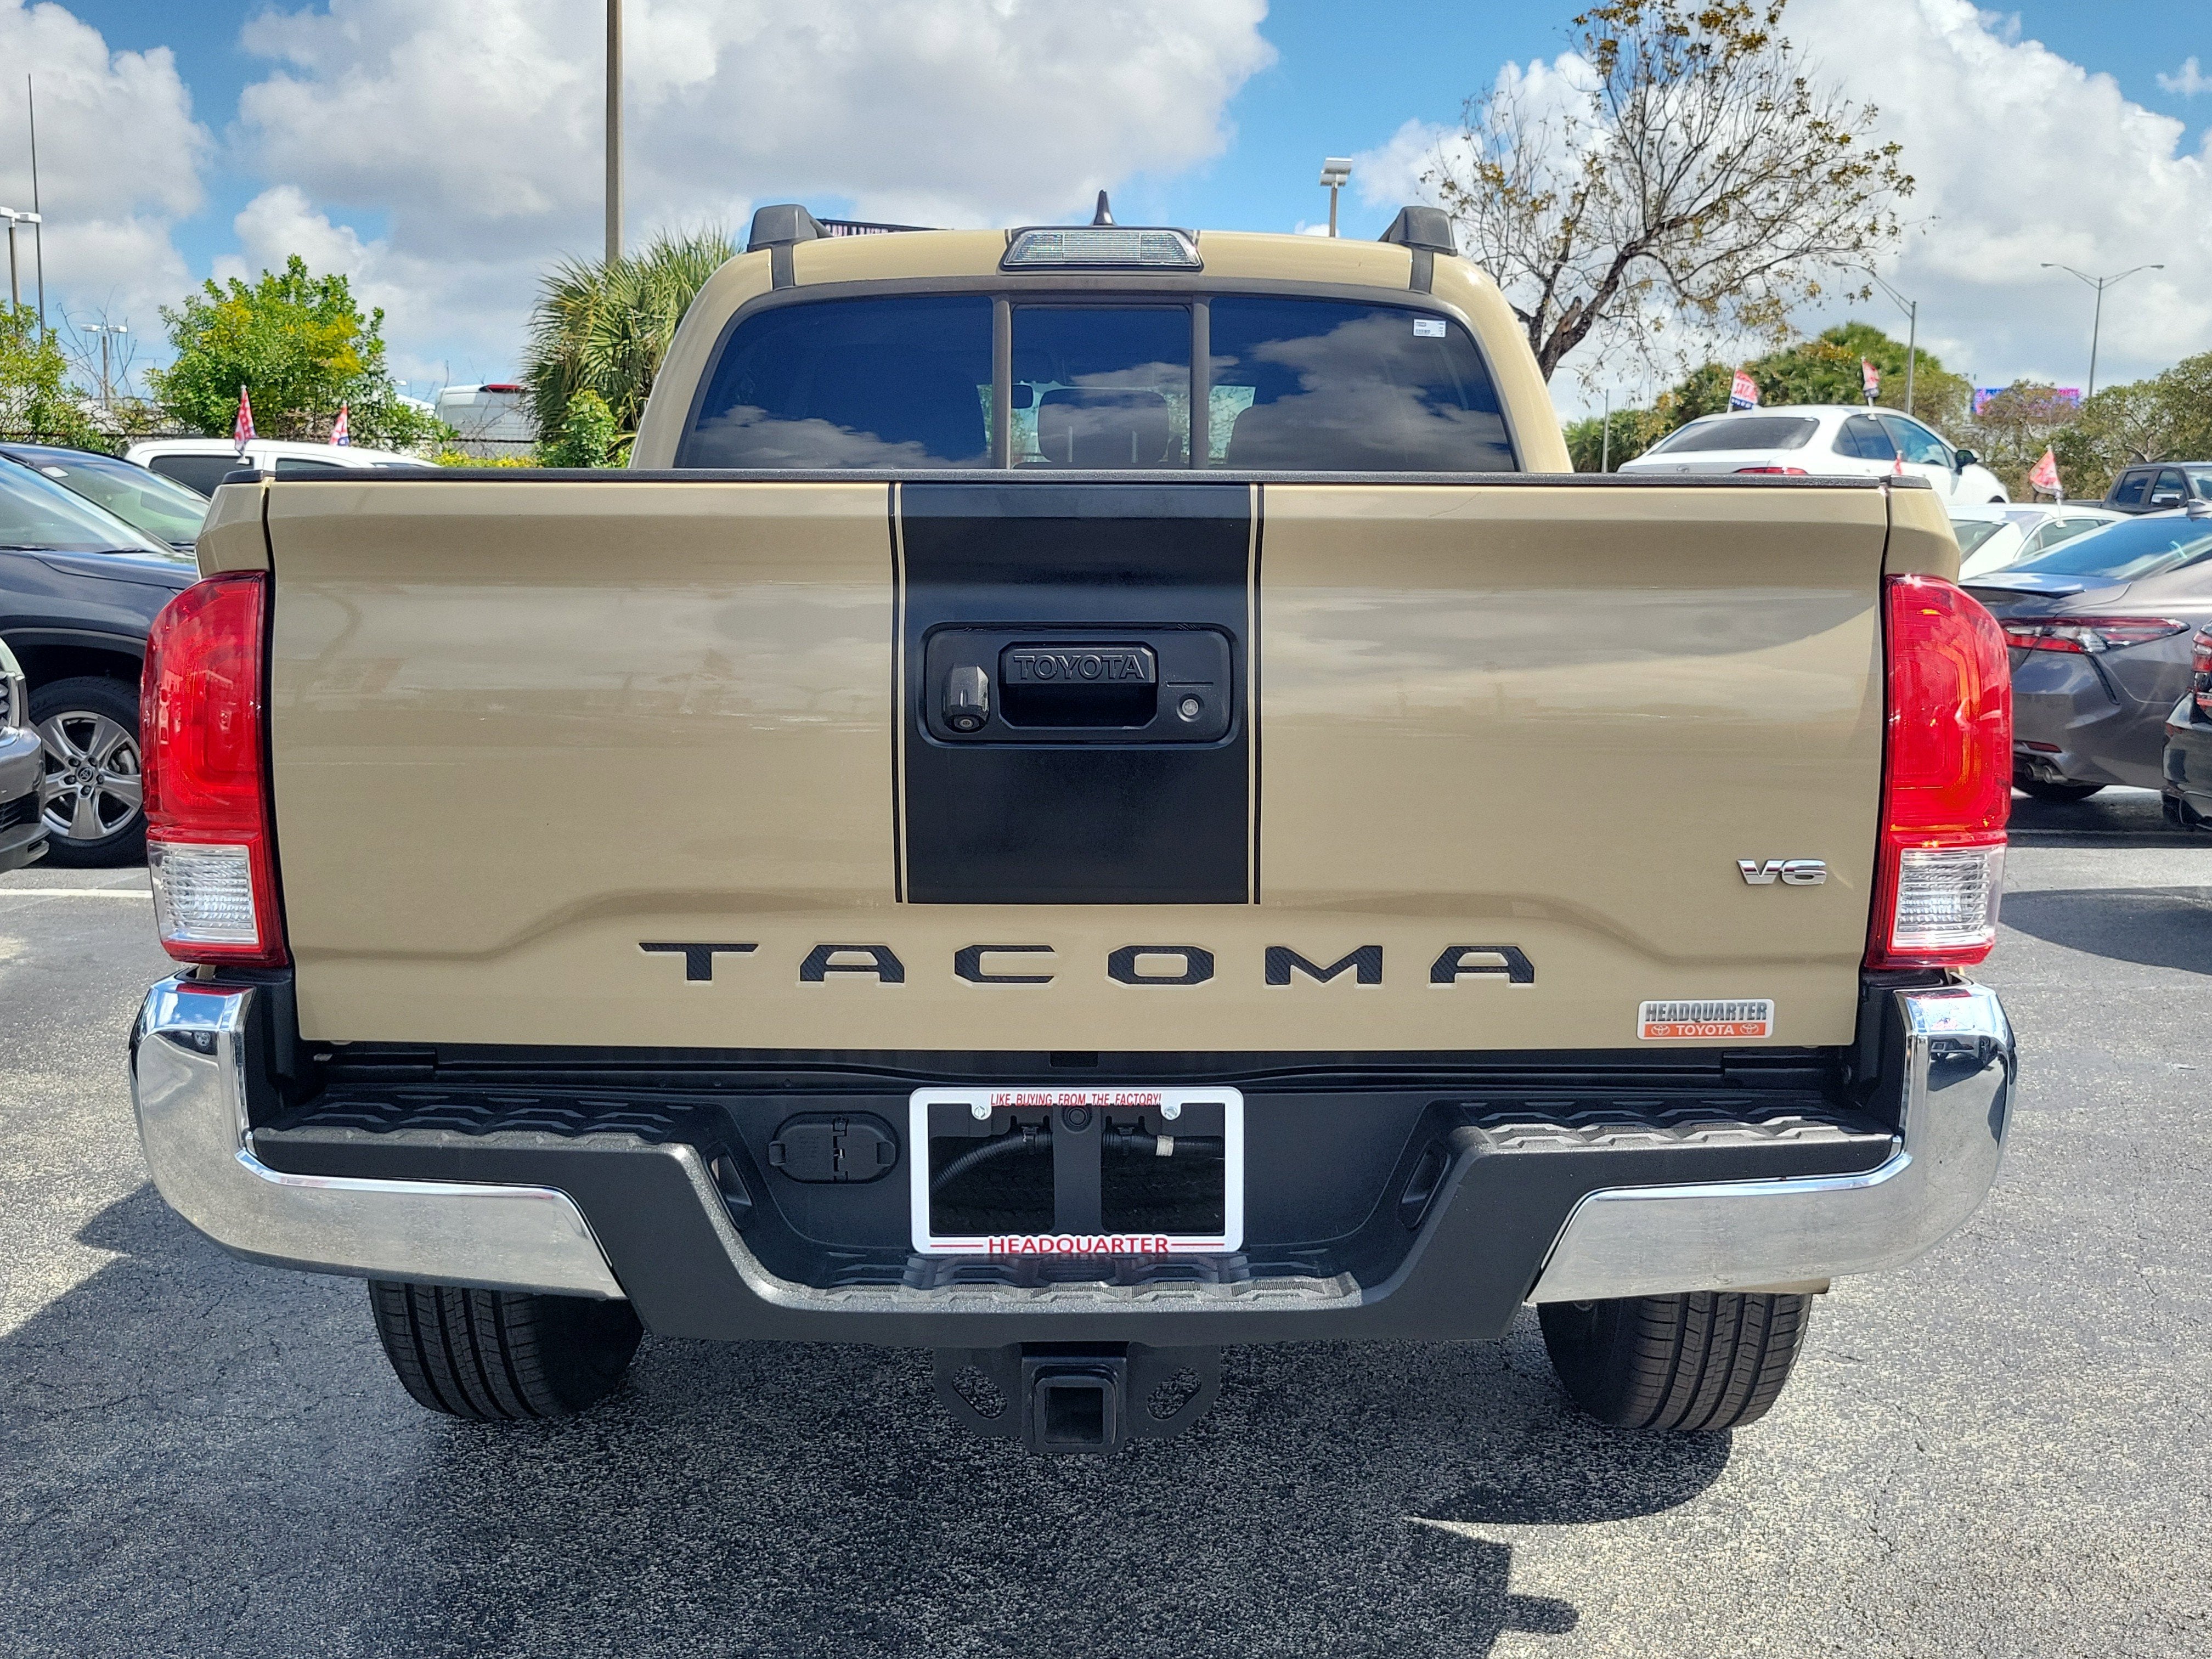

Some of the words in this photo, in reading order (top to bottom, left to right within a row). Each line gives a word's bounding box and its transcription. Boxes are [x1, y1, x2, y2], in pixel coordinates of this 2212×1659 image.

[1013, 655, 1146, 680] TOYOTA
[1736, 859, 1827, 885] V6
[639, 942, 1535, 985] TACOMA
[1645, 1002, 1768, 1023] HEADQUARTER
[1675, 1024, 1735, 1036] TOYOTA
[991, 1093, 1011, 1106] LIKE
[1016, 1093, 1052, 1106] BUYING
[1058, 1093, 1086, 1106] FROM
[1092, 1093, 1110, 1106] THE
[1115, 1093, 1162, 1106] FACTORY!
[988, 1238, 1169, 1254] HEADQUARTER
